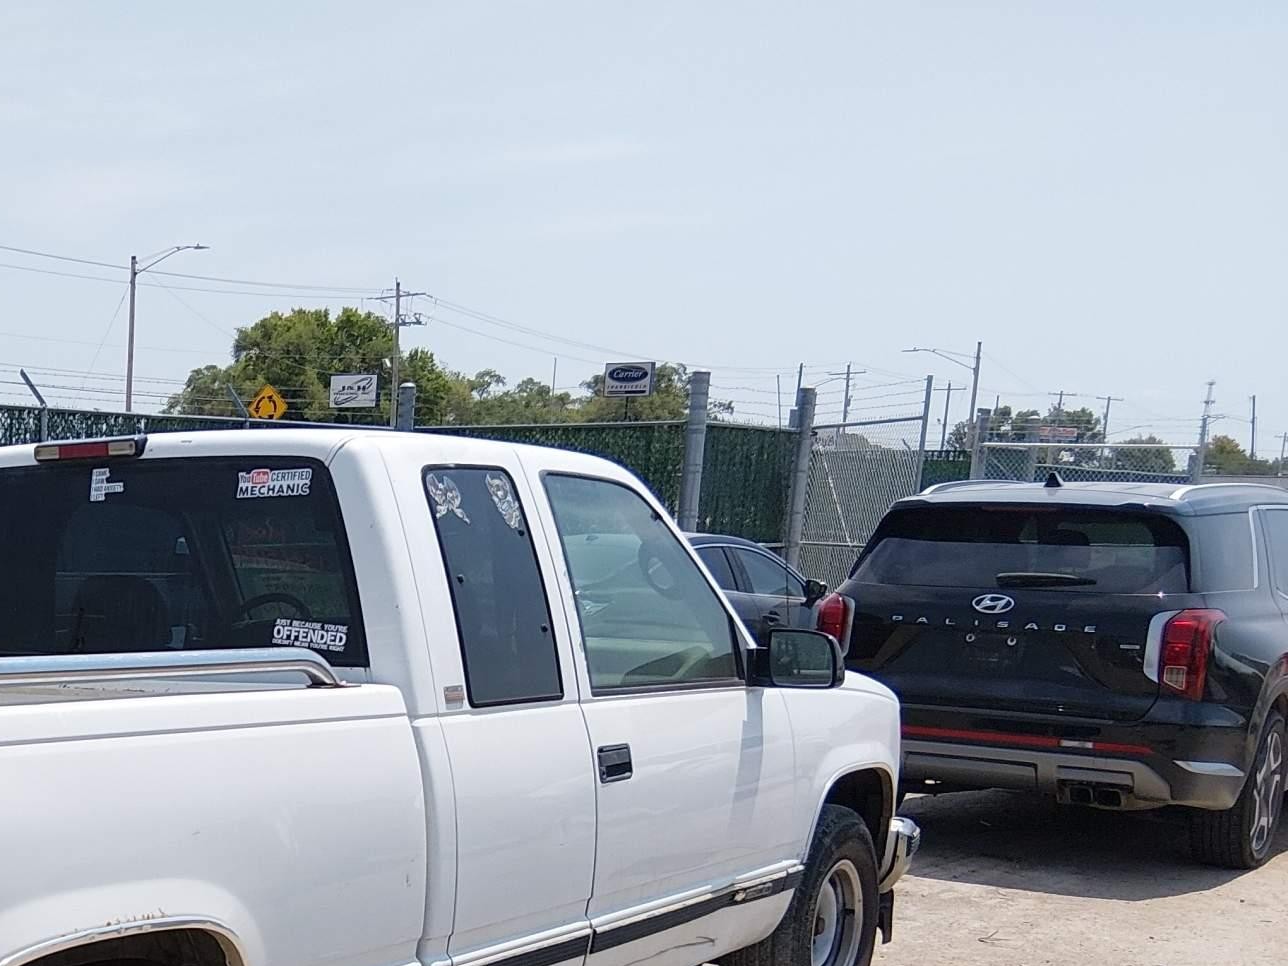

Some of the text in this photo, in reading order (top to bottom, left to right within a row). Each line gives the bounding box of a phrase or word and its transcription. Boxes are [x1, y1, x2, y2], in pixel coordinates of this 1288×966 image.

[613, 369, 642, 378] Carrier
[272, 471, 311, 482] CERTIFIED
[238, 482, 310, 497] MECHANIC
[276, 618, 291, 626] JUST
[292, 620, 322, 630] BECAUSE
[892, 615, 1097, 633] PALISADE
[273, 625, 347, 646] OFFENDED
